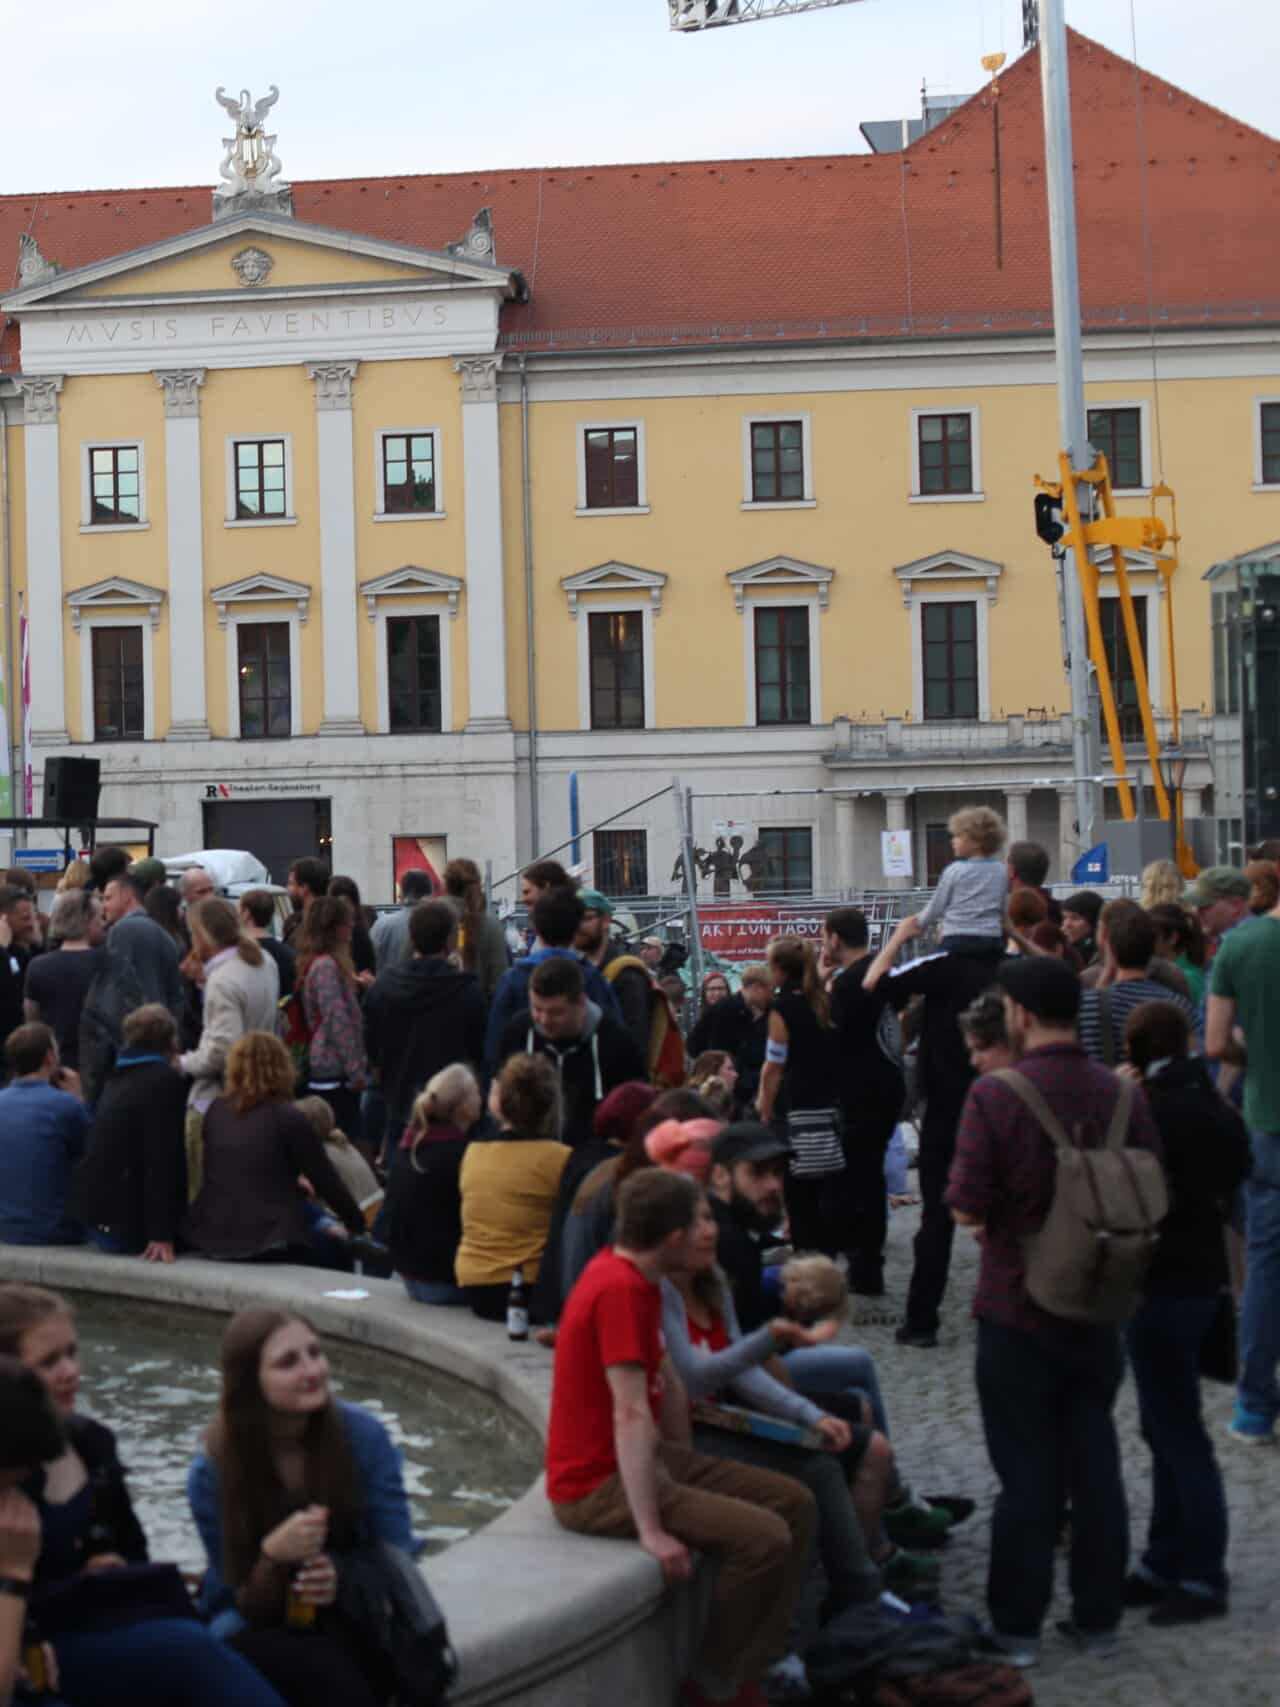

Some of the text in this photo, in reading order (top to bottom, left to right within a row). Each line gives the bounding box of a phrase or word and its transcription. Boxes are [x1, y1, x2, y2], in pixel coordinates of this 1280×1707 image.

[65, 304, 449, 345] MVSIS FAVENTIBVS
[702, 918, 772, 937] AKTION
